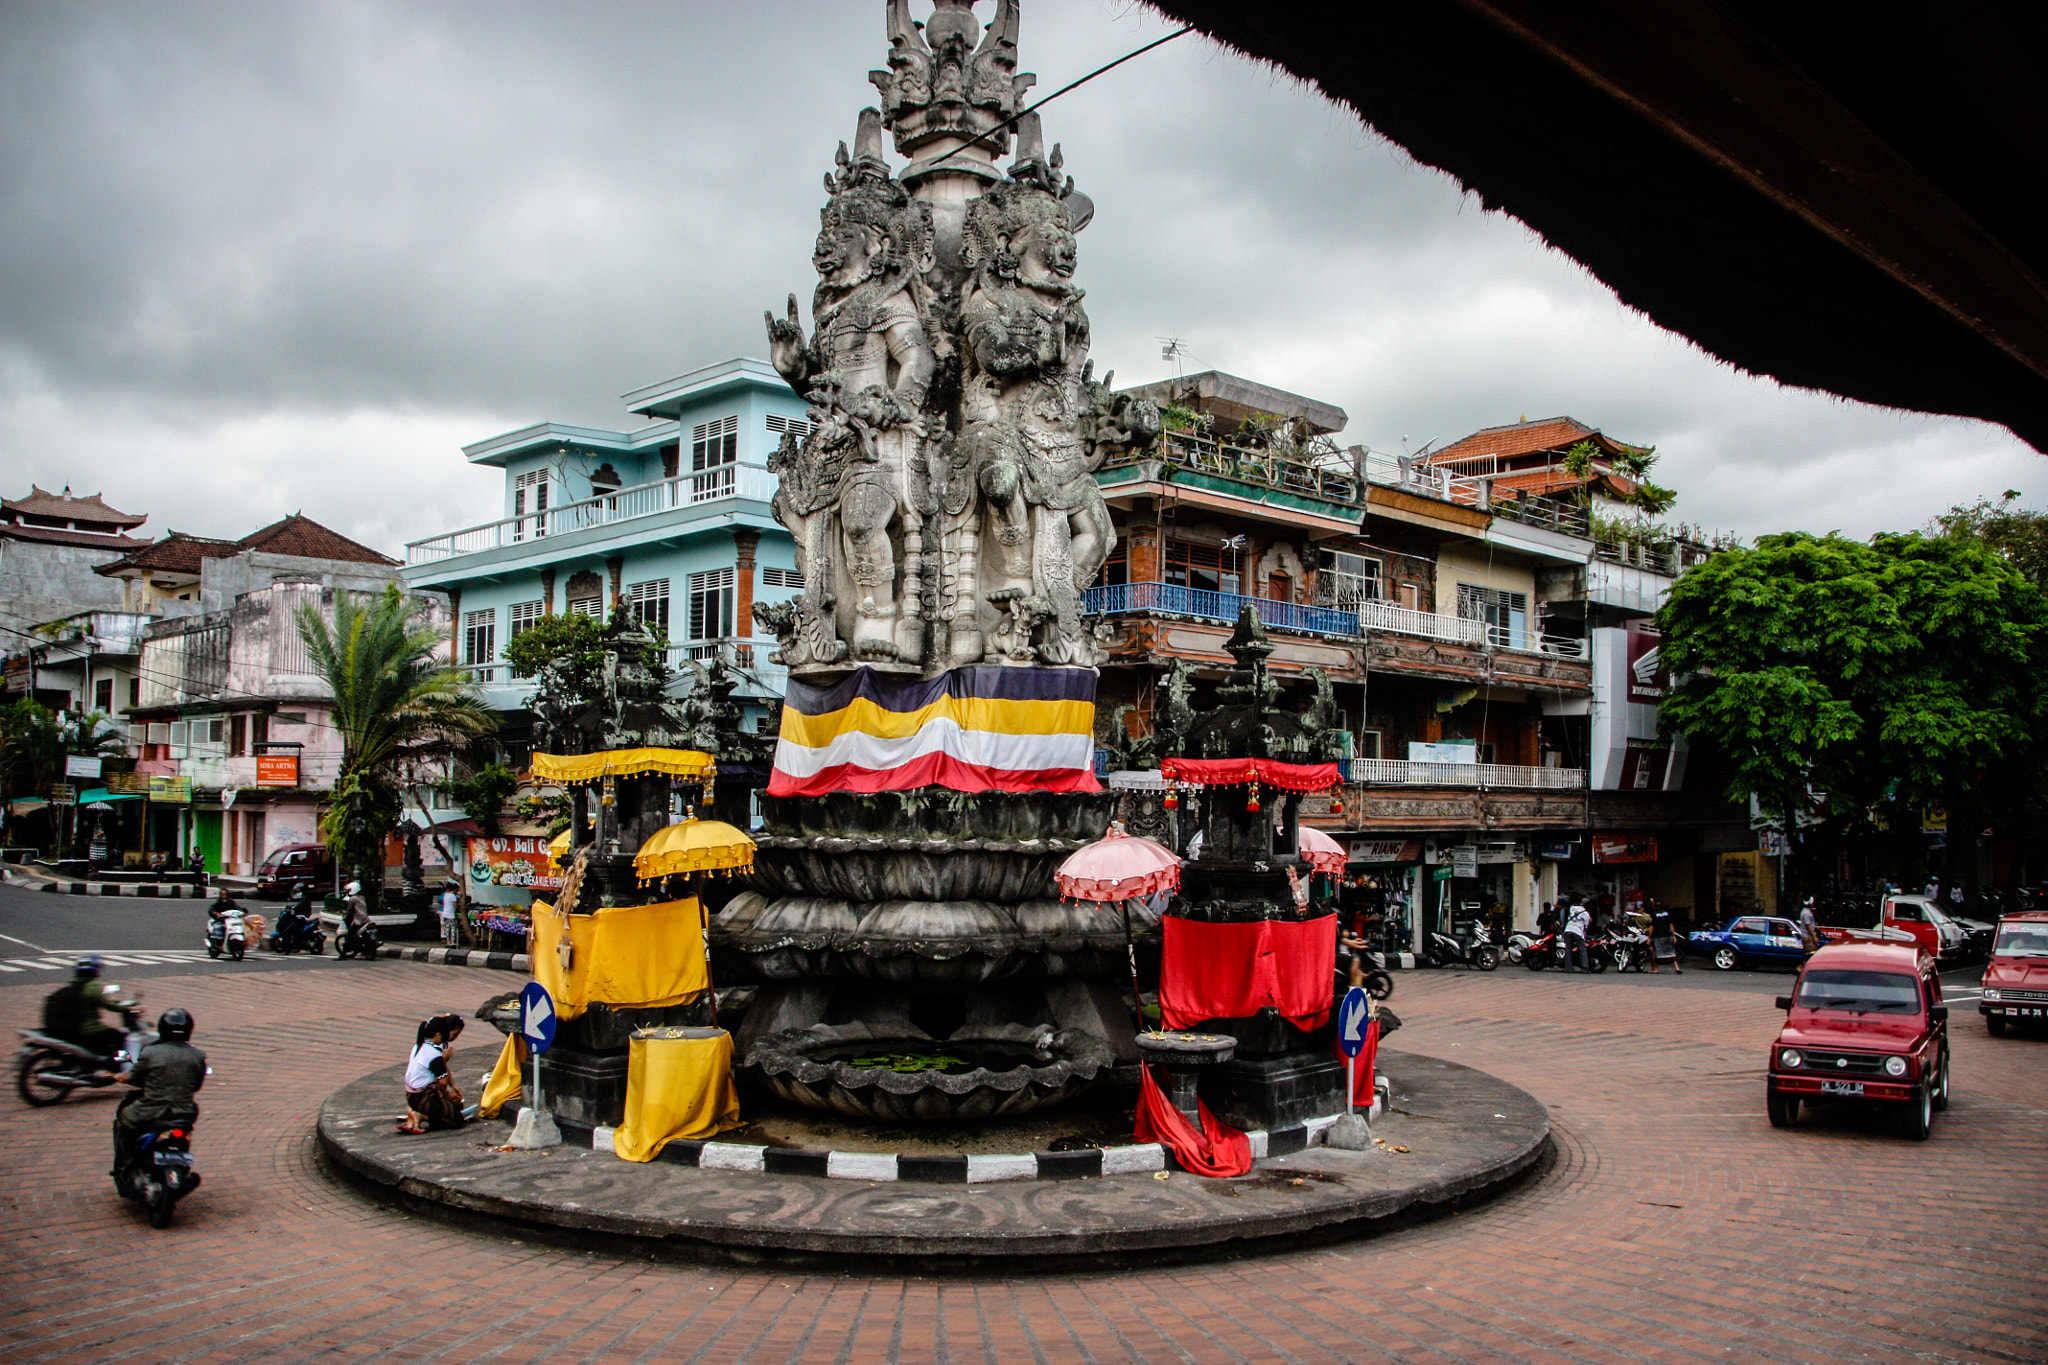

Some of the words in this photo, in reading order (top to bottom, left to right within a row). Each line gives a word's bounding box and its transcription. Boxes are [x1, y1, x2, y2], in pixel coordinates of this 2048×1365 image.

[259, 762, 275, 770] MIRA
[275, 762, 297, 770] ARTHA
[515, 838, 535, 854] Bali
[1371, 841, 1402, 855] RIANG
